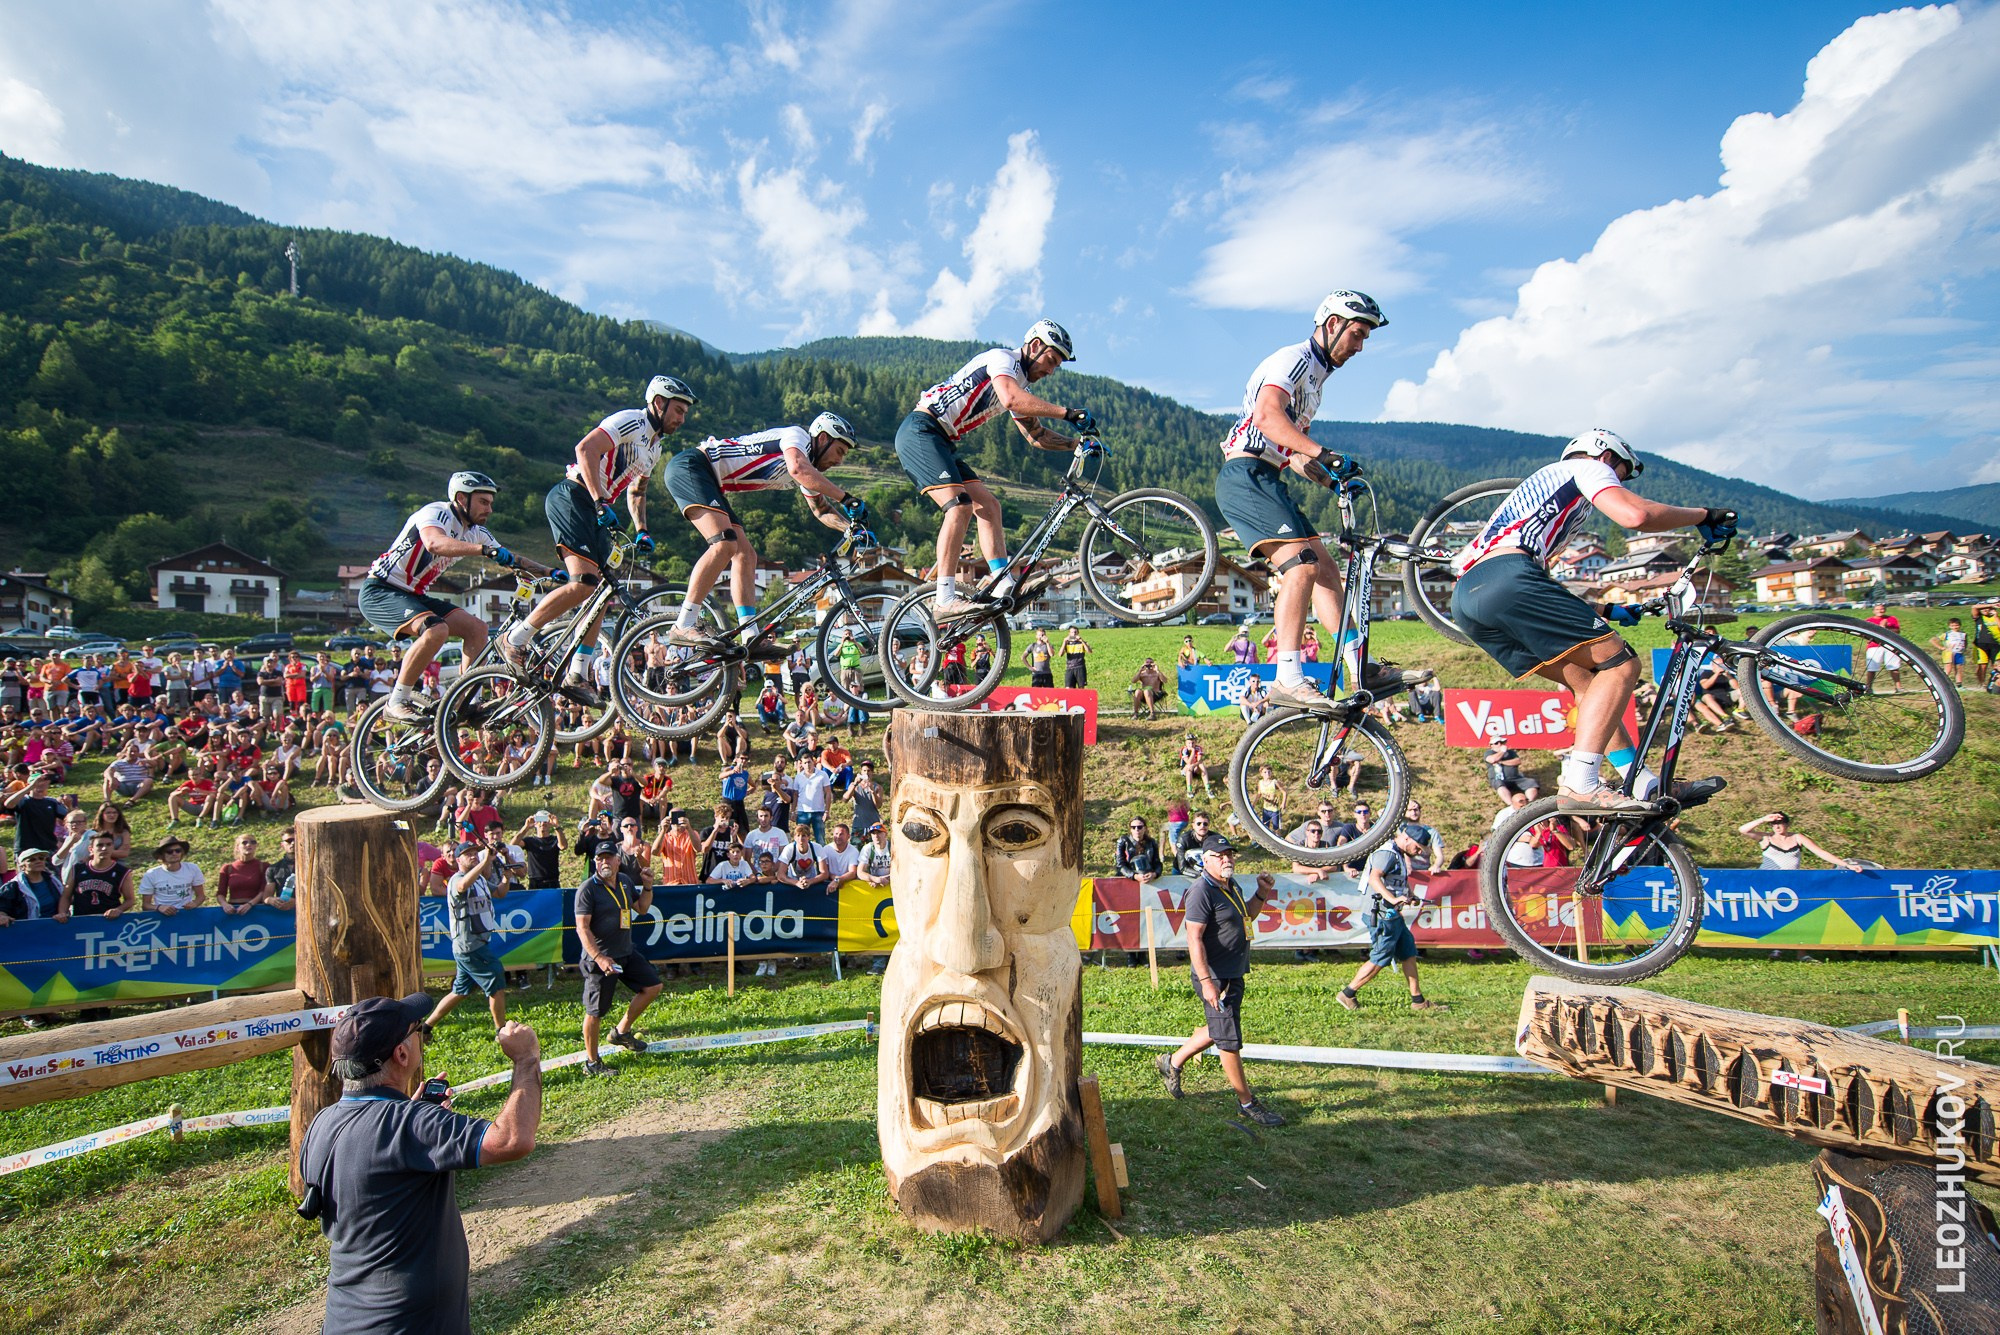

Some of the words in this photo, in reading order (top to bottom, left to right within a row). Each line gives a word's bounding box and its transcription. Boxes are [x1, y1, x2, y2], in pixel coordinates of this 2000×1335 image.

[746, 443, 764, 455] sky
[1538, 499, 1559, 523] sky
[521, 589, 529, 598] 2
[1456, 699, 1516, 740] Val
[1518, 713, 1543, 735] di
[91, 891, 100, 904] 1
[474, 900, 485, 910] TV
[1645, 880, 1799, 922] TRNTINO
[1457, 903, 1486, 930] di
[75, 923, 270, 973] TRENTINO
[8, 1064, 33, 1081] Val
[35, 1064, 47, 1075] di
[47, 1057, 85, 1074] Sole
[93, 1042, 160, 1065] TRENTINO
[174, 1034, 196, 1049] Val
[197, 1036, 208, 1046] di
[207, 1029, 238, 1045] Sole
[245, 1017, 301, 1038] TRENTINO
[312, 1012, 329, 1027] Val
[329, 1016, 337, 1024] di
